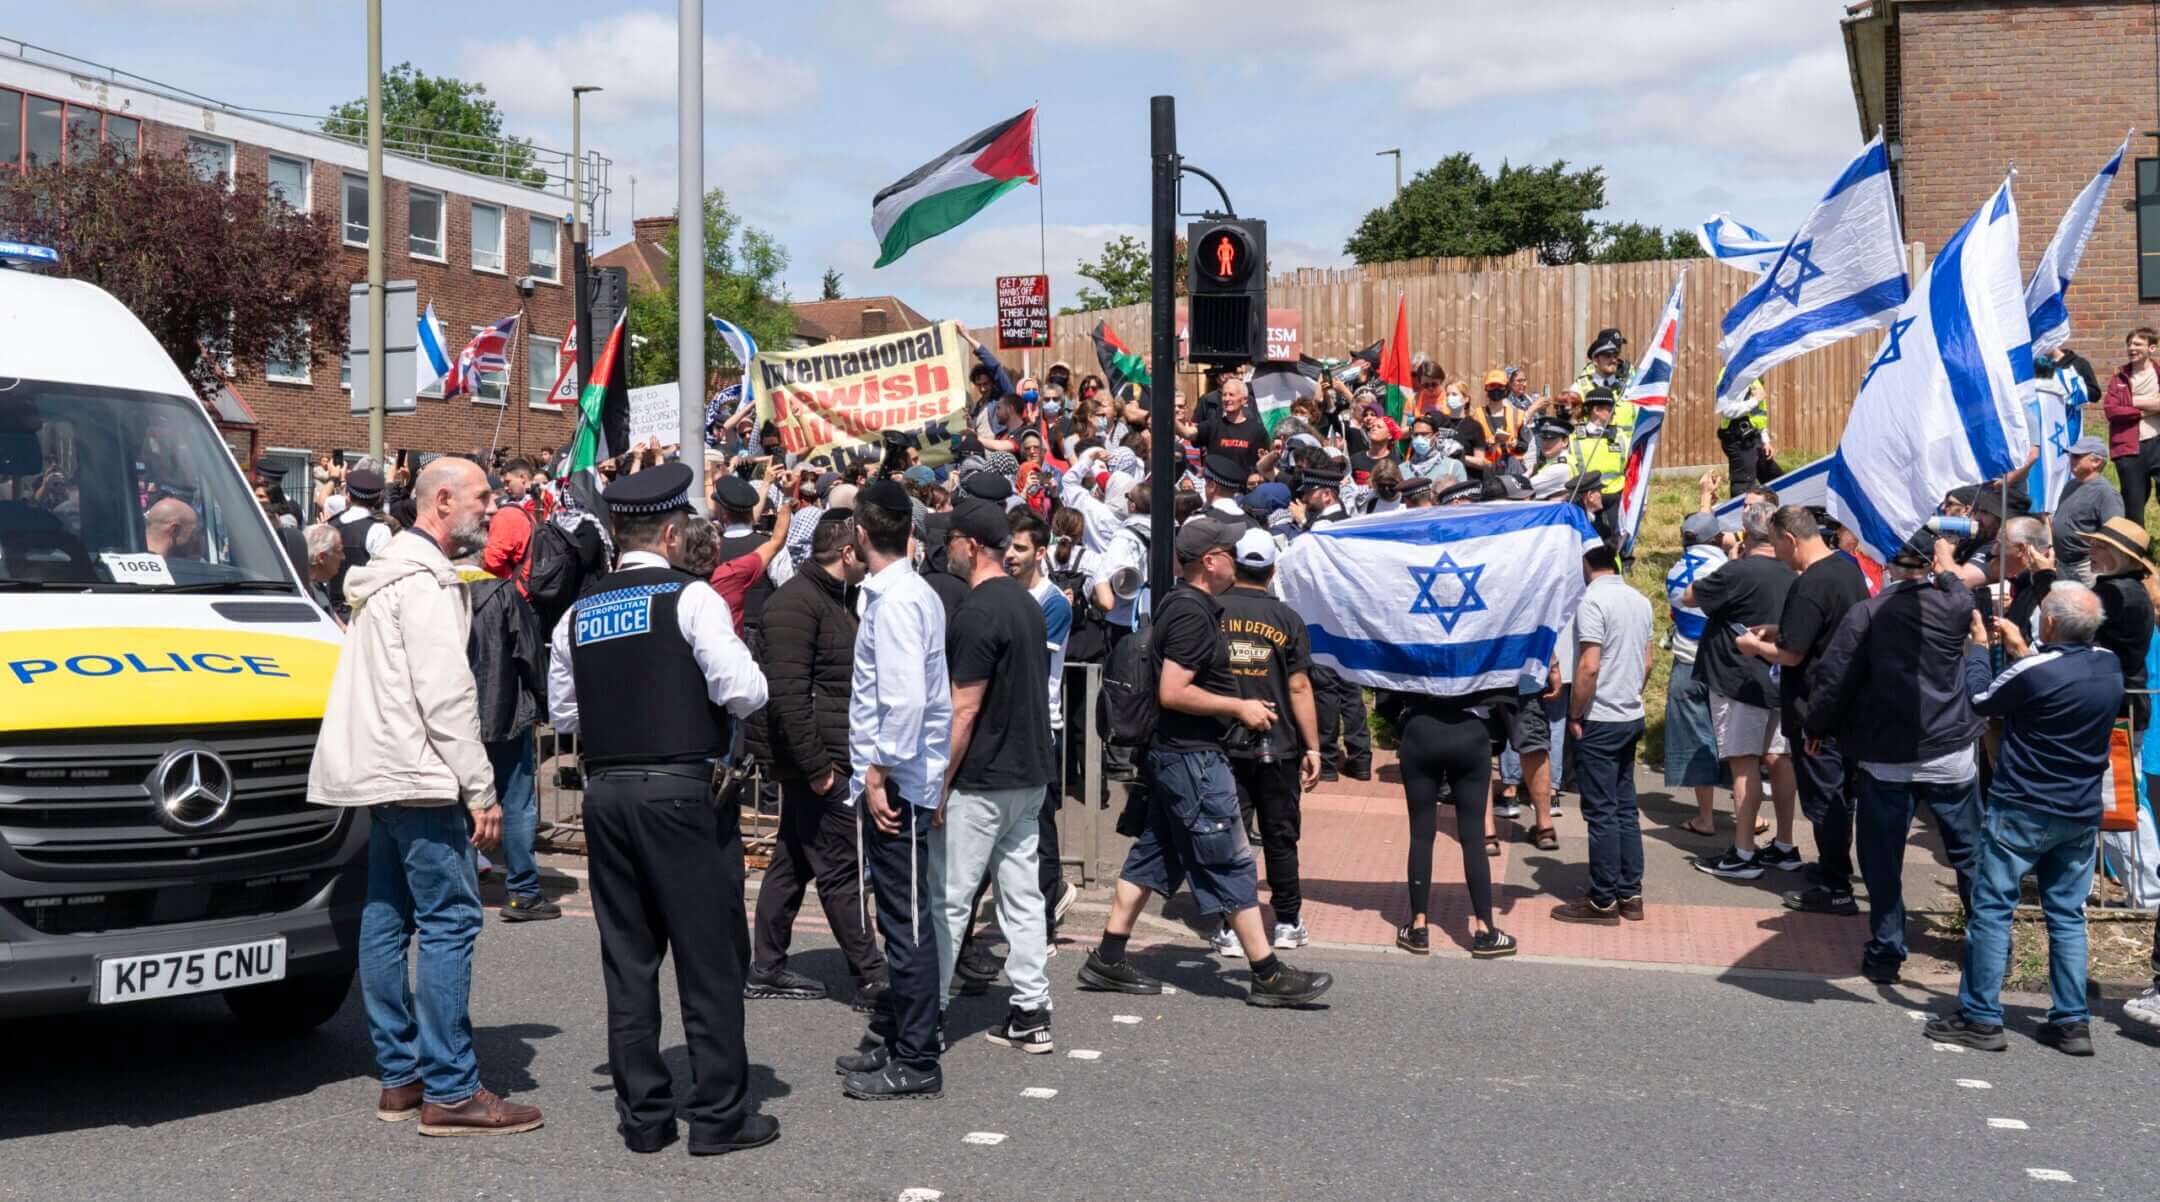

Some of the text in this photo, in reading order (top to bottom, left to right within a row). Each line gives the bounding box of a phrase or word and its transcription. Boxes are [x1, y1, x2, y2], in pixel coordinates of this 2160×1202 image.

[1000, 277, 1036, 289] GET YOUR
[1000, 286, 1035, 297] HANDS OFF
[1001, 319, 1012, 328] IS
[1013, 318, 1028, 327] NOT
[760, 325, 944, 390] International
[771, 363, 950, 423] Jewish
[118, 561, 162, 572] 106B
[579, 600, 647, 619] METROPOLITAN
[578, 608, 646, 641] POLICE
[1229, 619, 1242, 632] IN
[1245, 620, 1288, 646] DETROI
[8, 652, 291, 685] POLICE
[115, 944, 274, 995] KP75 CNU
